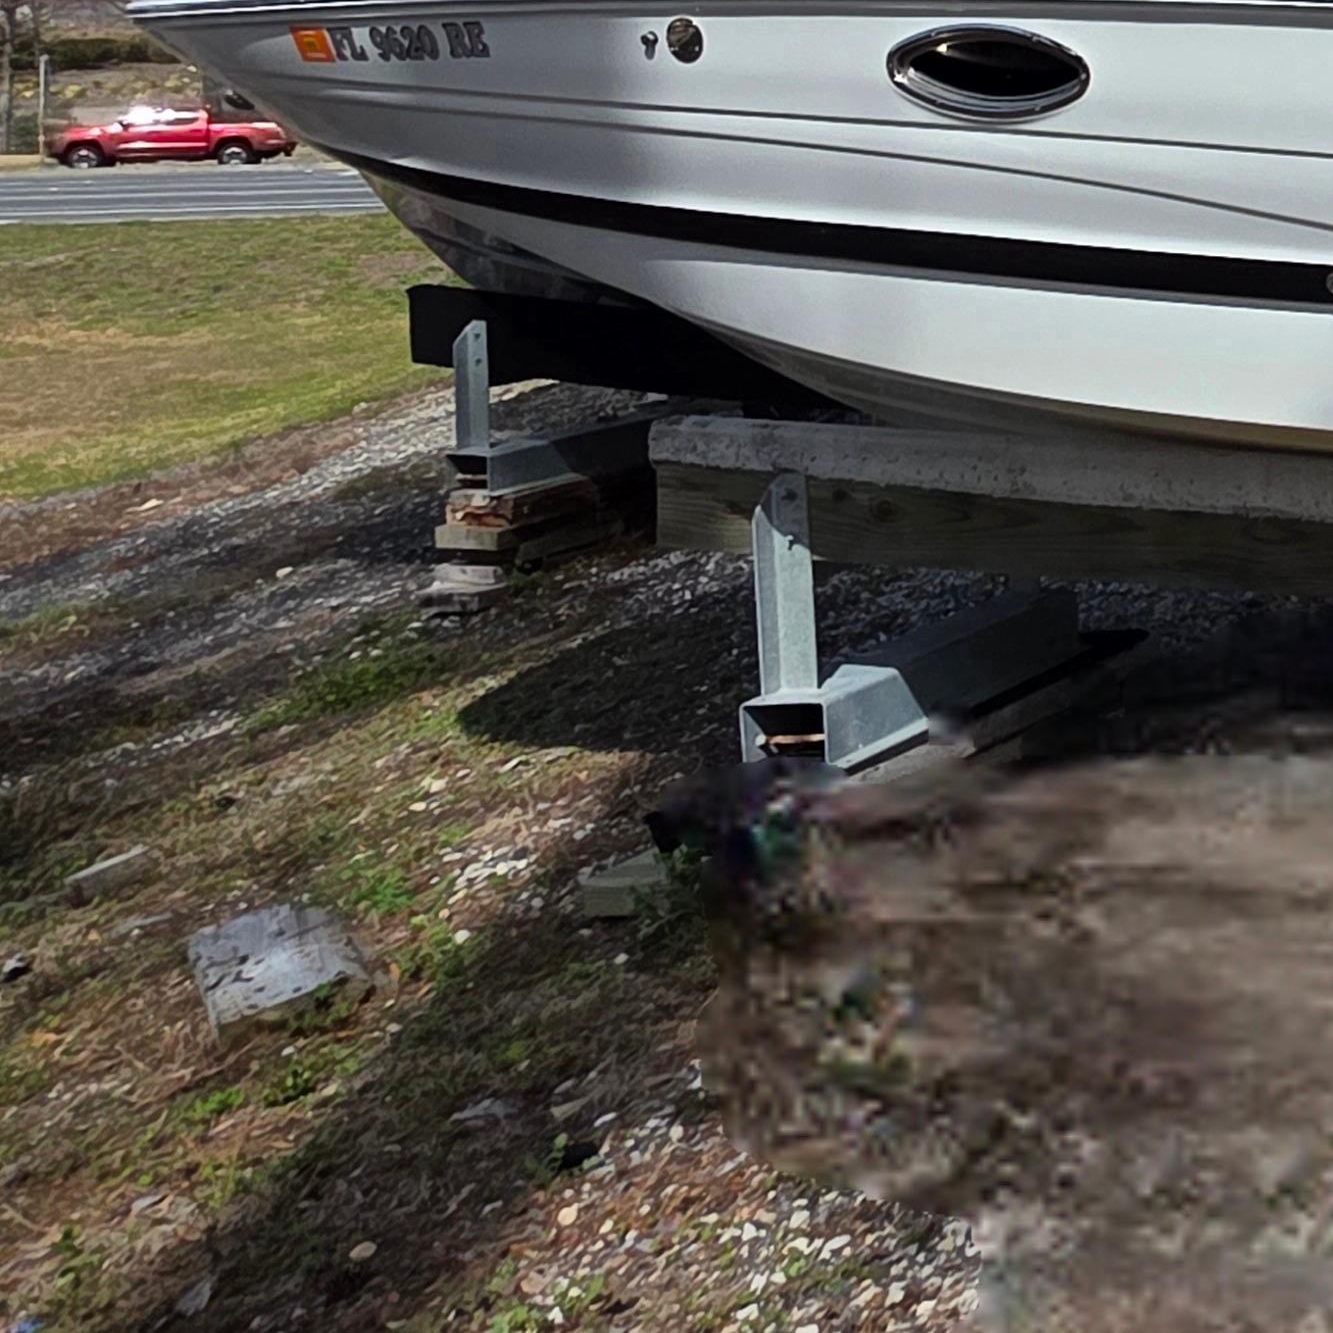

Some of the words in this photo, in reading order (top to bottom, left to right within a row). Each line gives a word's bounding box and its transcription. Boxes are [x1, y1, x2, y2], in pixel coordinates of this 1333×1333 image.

[326, 26, 370, 62] FL
[368, 23, 441, 62] 9620
[441, 20, 491, 59] RE
